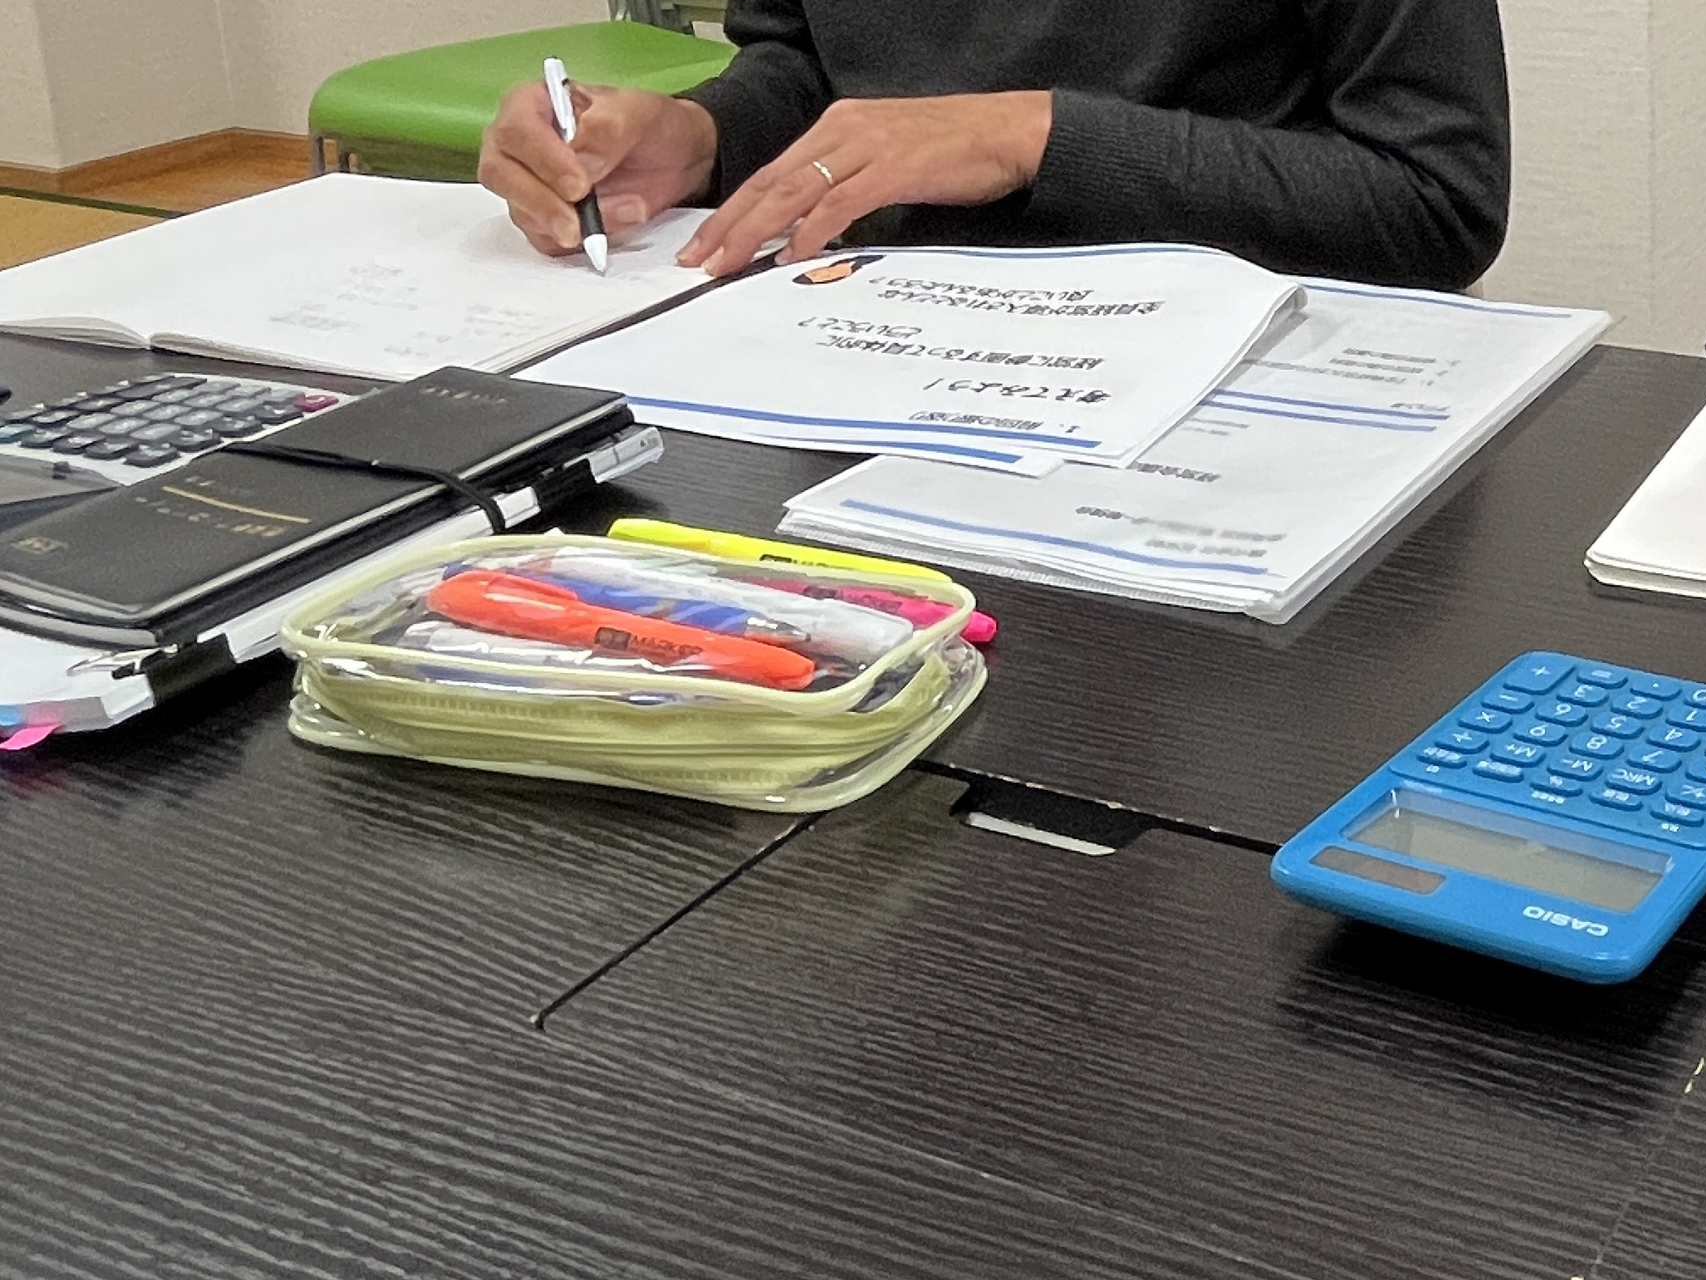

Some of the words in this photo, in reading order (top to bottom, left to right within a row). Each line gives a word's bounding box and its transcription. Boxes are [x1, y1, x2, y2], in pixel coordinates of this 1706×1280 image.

[1554, 702, 1572, 716] 6
[1627, 696, 1647, 709] 2
[1685, 709, 1698, 722] 1
[1529, 723, 1549, 737] 9
[1664, 728, 1683, 742] 4
[1586, 735, 1608, 750] 8
[1610, 768, 1656, 786] MRC
[1522, 905, 1609, 937] CASIO
